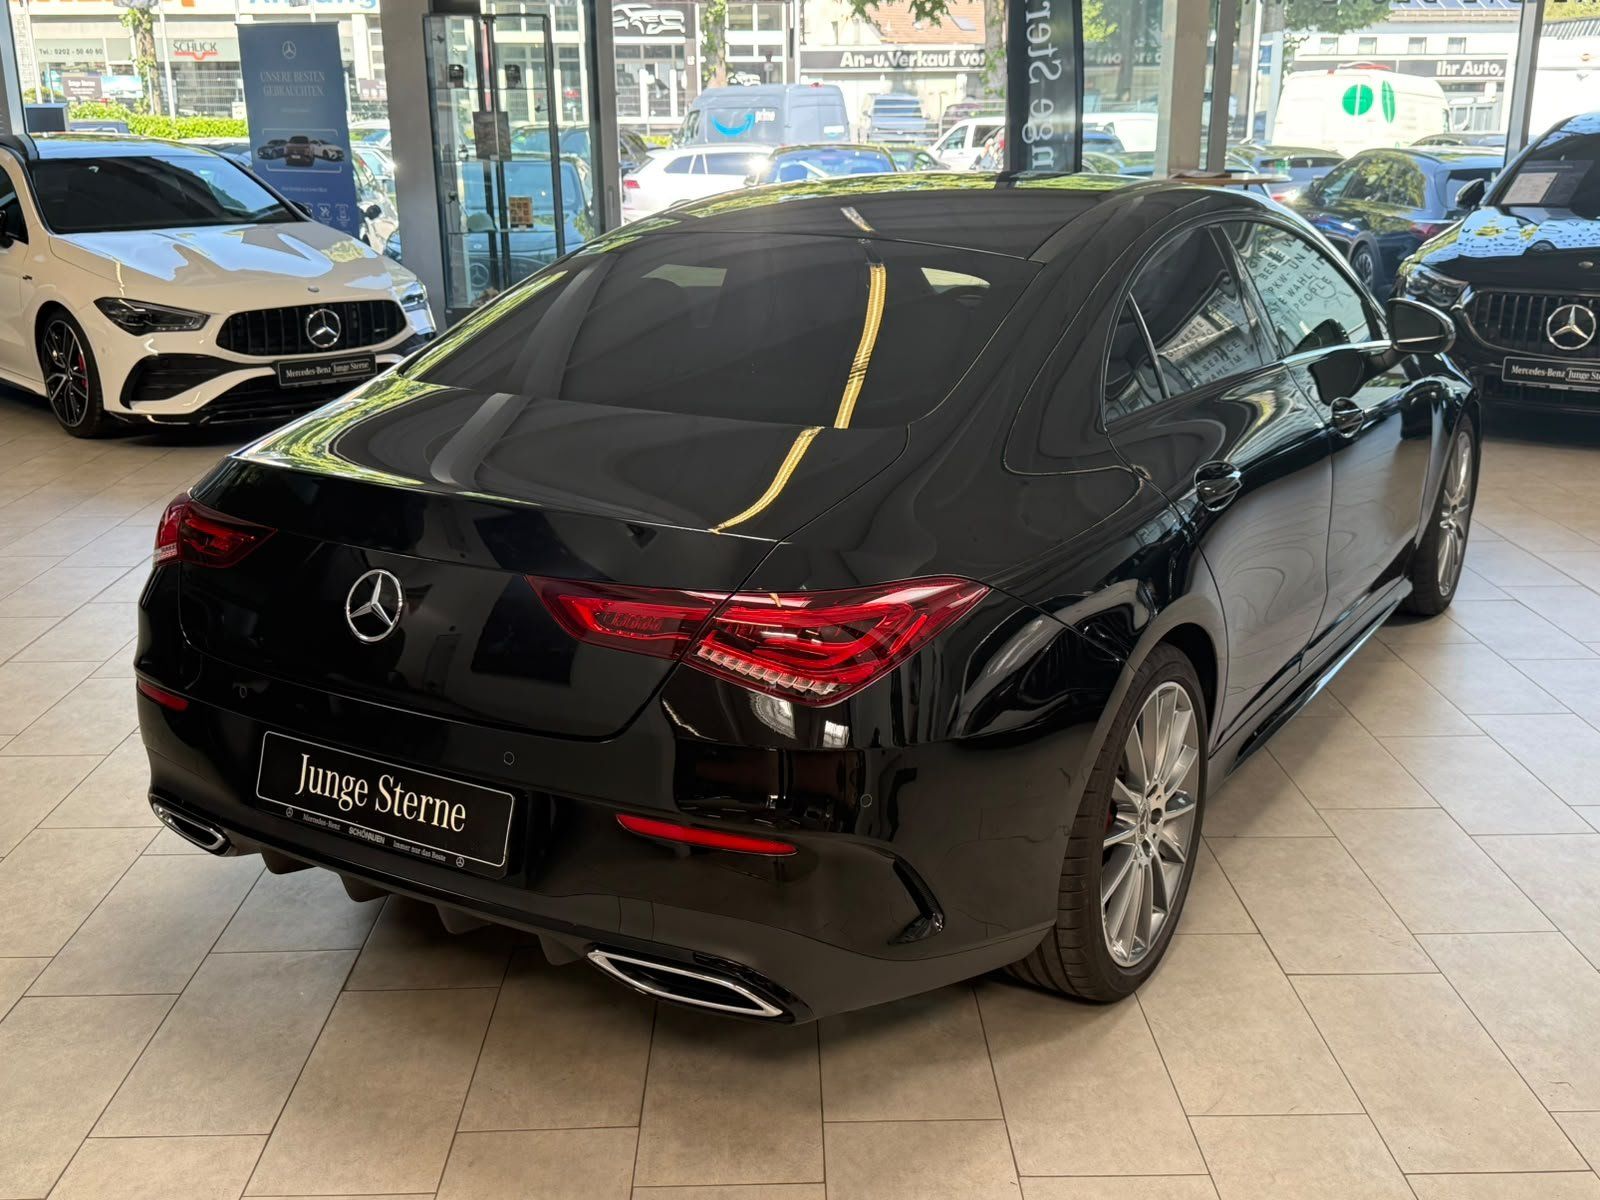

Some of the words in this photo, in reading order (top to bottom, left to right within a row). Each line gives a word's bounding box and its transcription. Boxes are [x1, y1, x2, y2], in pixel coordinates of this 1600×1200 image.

[260, 71, 293, 82] UNSERE
[293, 71, 325, 82] BESTEN
[1436, 61, 1457, 76] Ihr
[1460, 61, 1504, 77] Auto,
[1286, 271, 1313, 298] WAHL
[1293, 275, 1332, 311] PEOPLE
[285, 366, 332, 378] Mercedes-Benz
[333, 364, 350, 373] Junge
[350, 362, 369, 370] Sterne
[1511, 365, 1566, 378] Mercedes-Benz
[1568, 369, 1590, 380] Junge
[295, 753, 369, 811] Junge
[375, 774, 466, 832] Sterne
[303, 813, 341, 830] Mercedes-Benz
[421, 849, 431, 857] das
[431, 851, 446, 862] Beste
